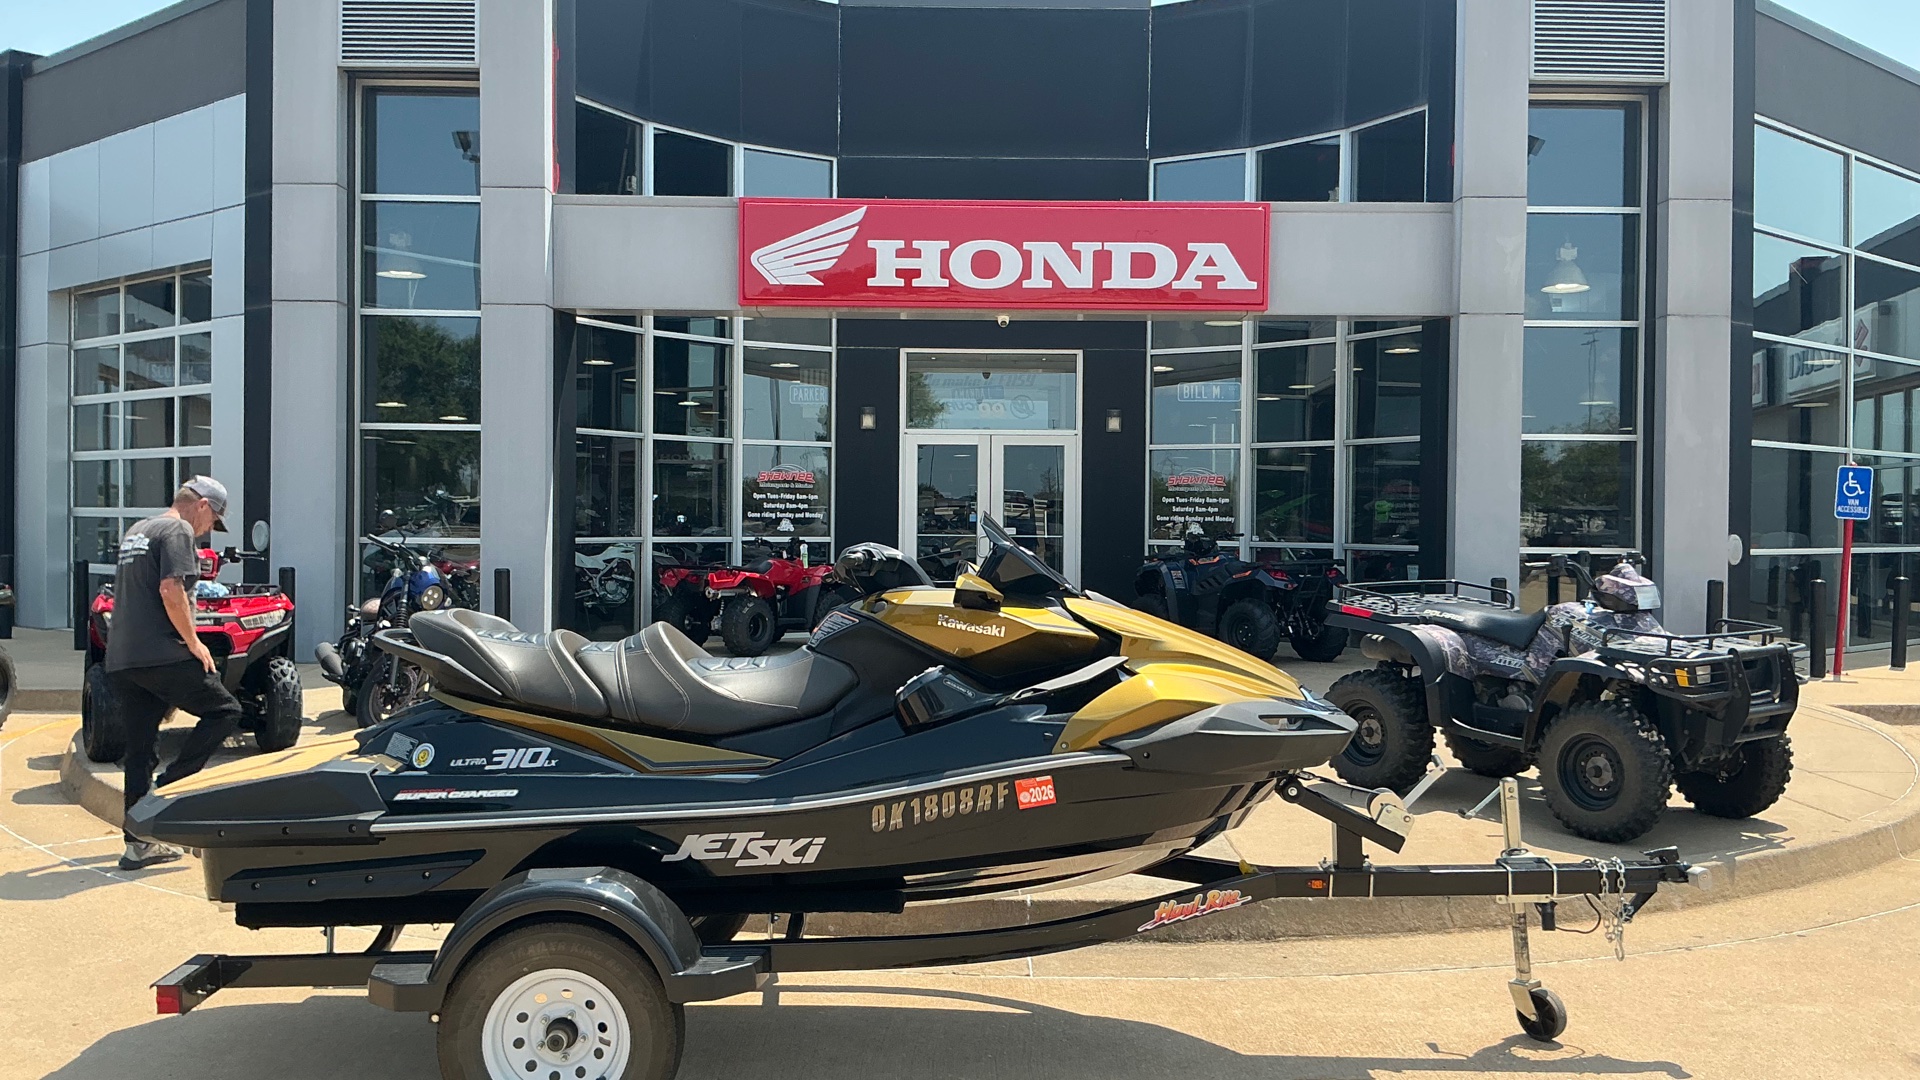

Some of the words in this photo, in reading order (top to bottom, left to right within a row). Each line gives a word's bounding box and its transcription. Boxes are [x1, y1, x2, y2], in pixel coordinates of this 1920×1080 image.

[866, 239, 1258, 290] HONDA
[793, 388, 825, 401] PARKER
[1183, 385, 1208, 399] BILL
[1212, 385, 1224, 399] M.
[1837, 505, 1868, 514] ACCESSIBLE
[1423, 608, 1465, 622] POLARIS
[937, 614, 1006, 638] Kawasaki
[450, 758, 487, 767] ULTRA
[484, 747, 551, 770] 310
[544, 759, 559, 768] LX
[393, 791, 448, 801] SUPER
[448, 789, 519, 799] CHARGED
[1030, 784, 1055, 803] 2026
[872, 782, 1009, 833] OK1808RF
[661, 831, 765, 862] JET
[1155, 894, 1203, 922] Haul
[1205, 890, 1242, 911] Rite
